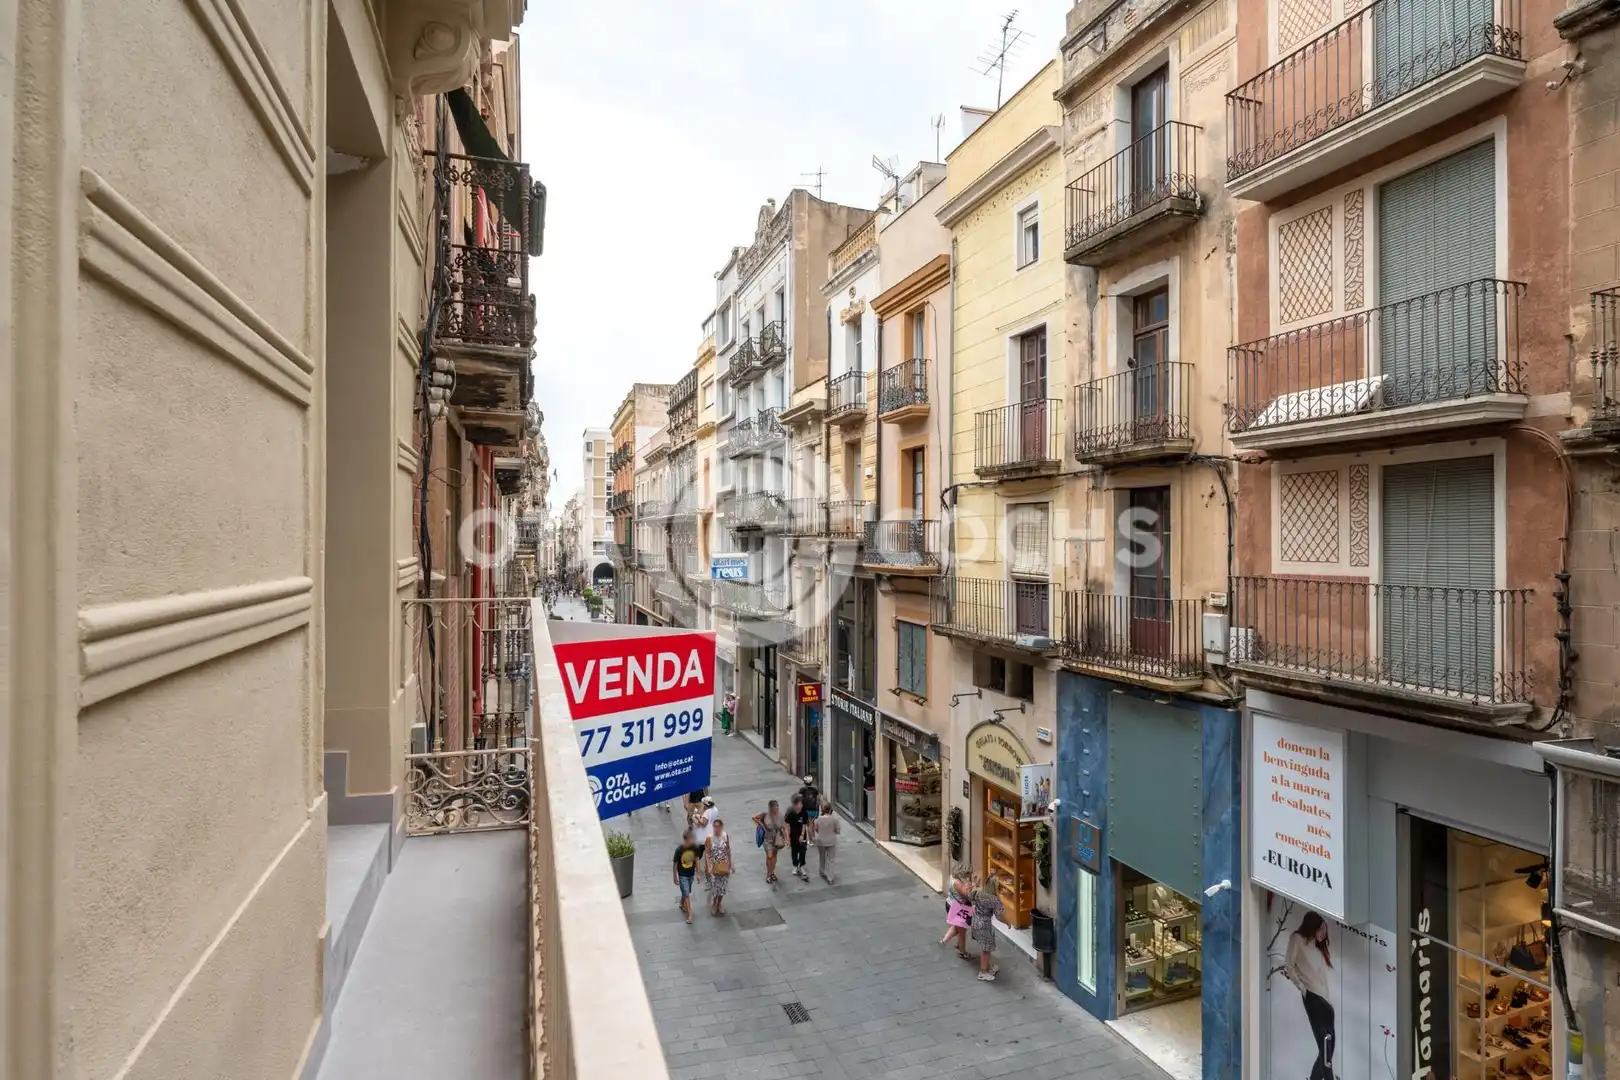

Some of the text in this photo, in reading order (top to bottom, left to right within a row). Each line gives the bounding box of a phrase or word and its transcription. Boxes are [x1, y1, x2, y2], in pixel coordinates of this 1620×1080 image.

[716, 567, 743, 578] reus
[564, 649, 704, 704] VENDA
[849, 702, 873, 726] ITALIANE
[620, 716, 655, 748] 311
[663, 707, 704, 739] 999
[1277, 736, 1330, 762] donem la
[654, 765, 692, 781] www.ota.cat
[1263, 751, 1330, 781] benvinguda
[605, 781, 647, 804] COCHS
[606, 772, 631, 790] OTA
[1271, 774, 1330, 800] a la marca
[1271, 790, 1331, 820] de sabates
[1307, 823, 1332, 840] més
[1275, 830, 1332, 860] coneguda
